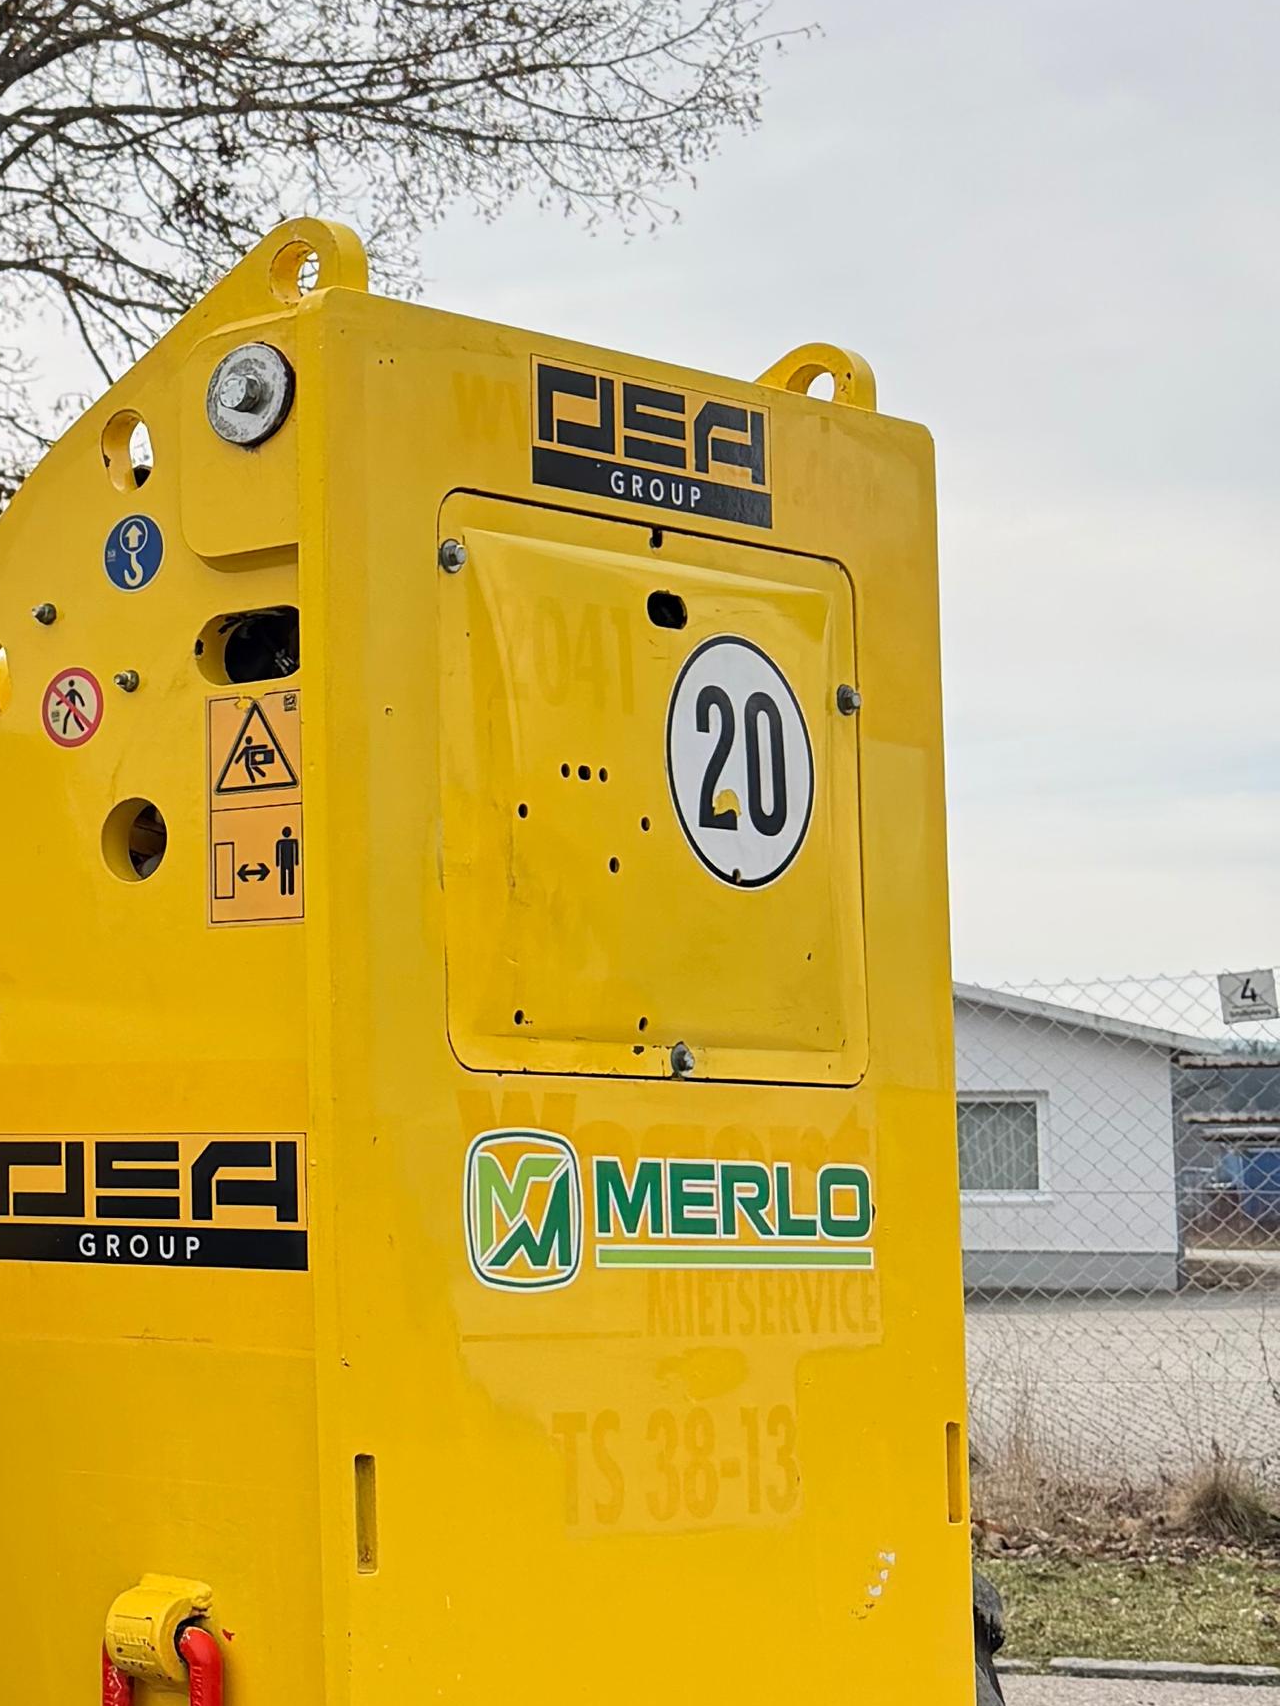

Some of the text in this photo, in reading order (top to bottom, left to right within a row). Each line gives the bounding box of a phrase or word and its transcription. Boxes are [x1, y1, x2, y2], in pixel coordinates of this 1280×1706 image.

[610, 471, 702, 508] GROUP
[695, 684, 788, 837] 20
[1240, 977, 1257, 1003] 4
[592, 1155, 874, 1242] MERLO
[78, 1232, 201, 1260] GROUP
[646, 1270, 880, 1338] MIETSERVICE
[550, 1402, 803, 1527] TS 38-13
